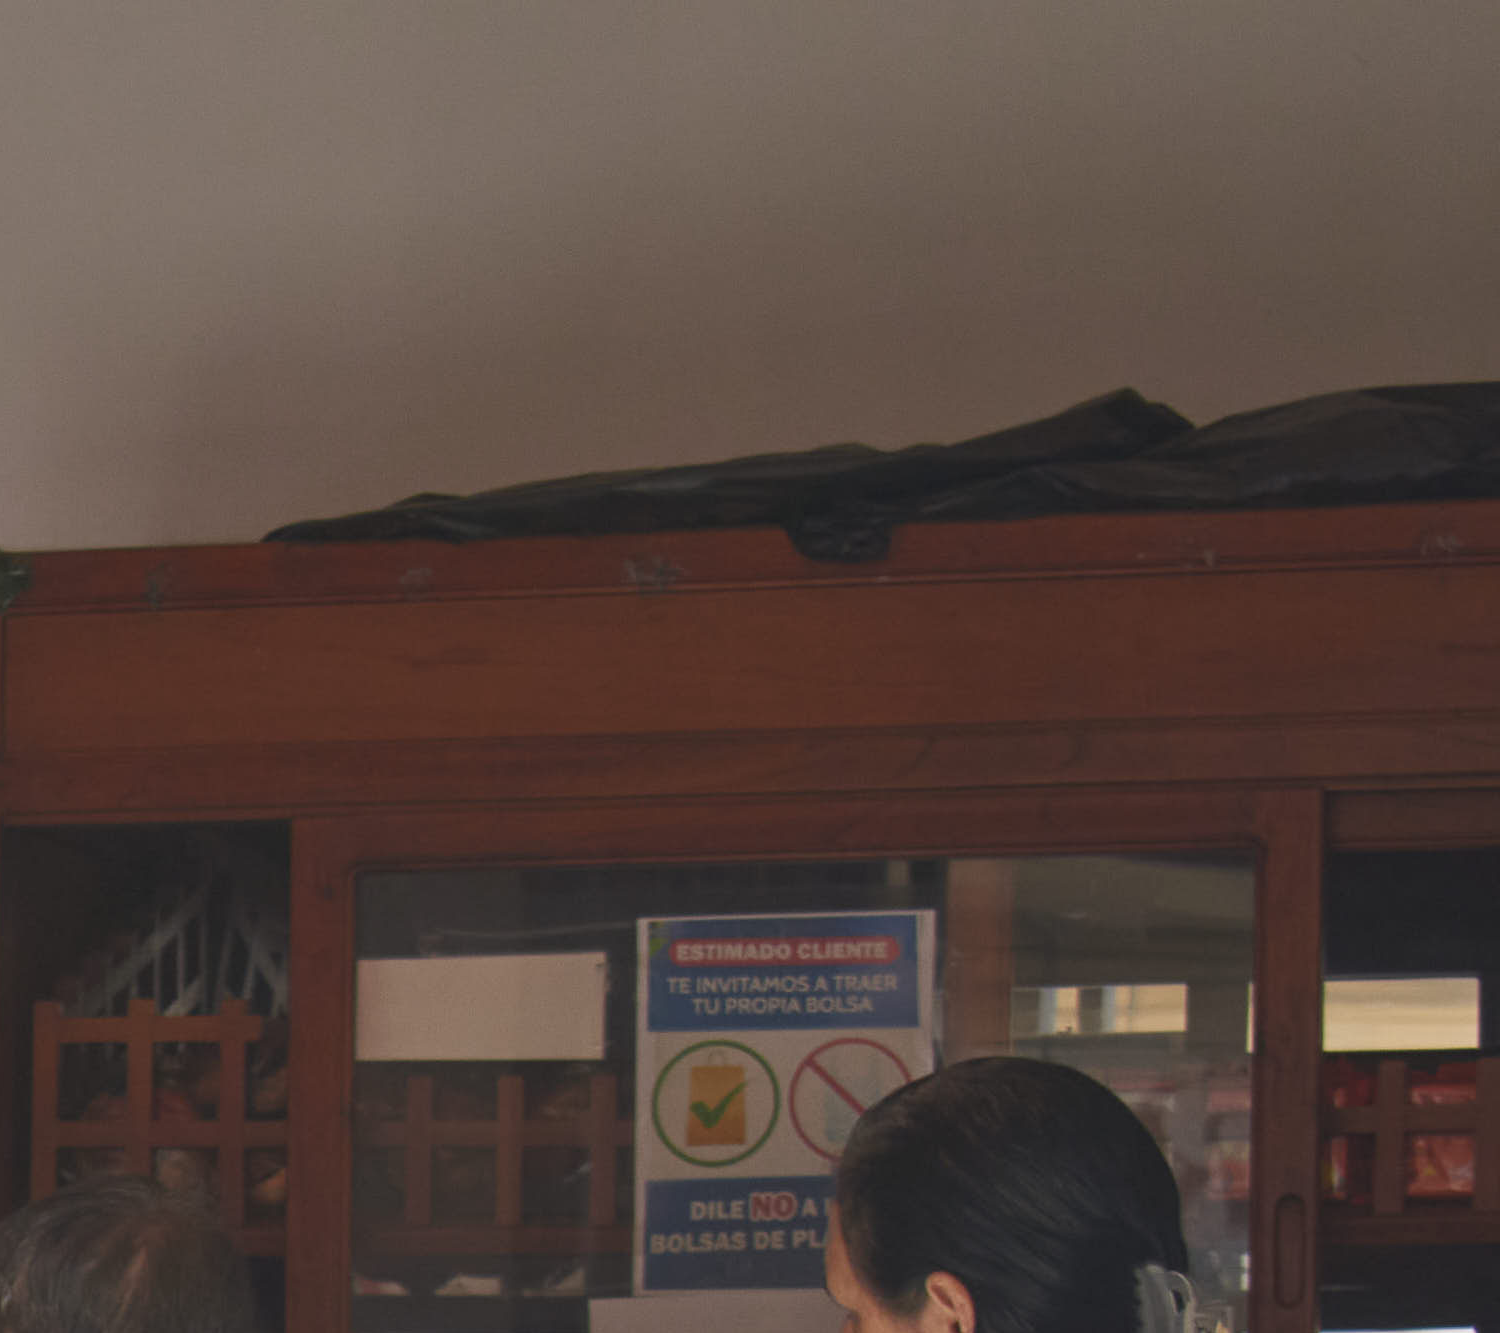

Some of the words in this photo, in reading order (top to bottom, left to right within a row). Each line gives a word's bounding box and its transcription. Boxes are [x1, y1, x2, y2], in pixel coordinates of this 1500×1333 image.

[675, 942, 791, 961] ESTIMADO
[797, 940, 889, 960] CLIENTE
[667, 976, 693, 994] TE
[696, 975, 810, 994] INVITAMOS
[813, 976, 829, 993] A
[833, 973, 899, 992] TRAER
[691, 997, 721, 1015] TU
[725, 996, 802, 1015] PROPIA
[805, 994, 875, 1014] BOLSA
[689, 1200, 745, 1221] DILE
[750, 1192, 797, 1222] NO
[802, 1197, 818, 1217] A
[650, 1231, 748, 1255] BOLSAS
[753, 1230, 786, 1250] DE
